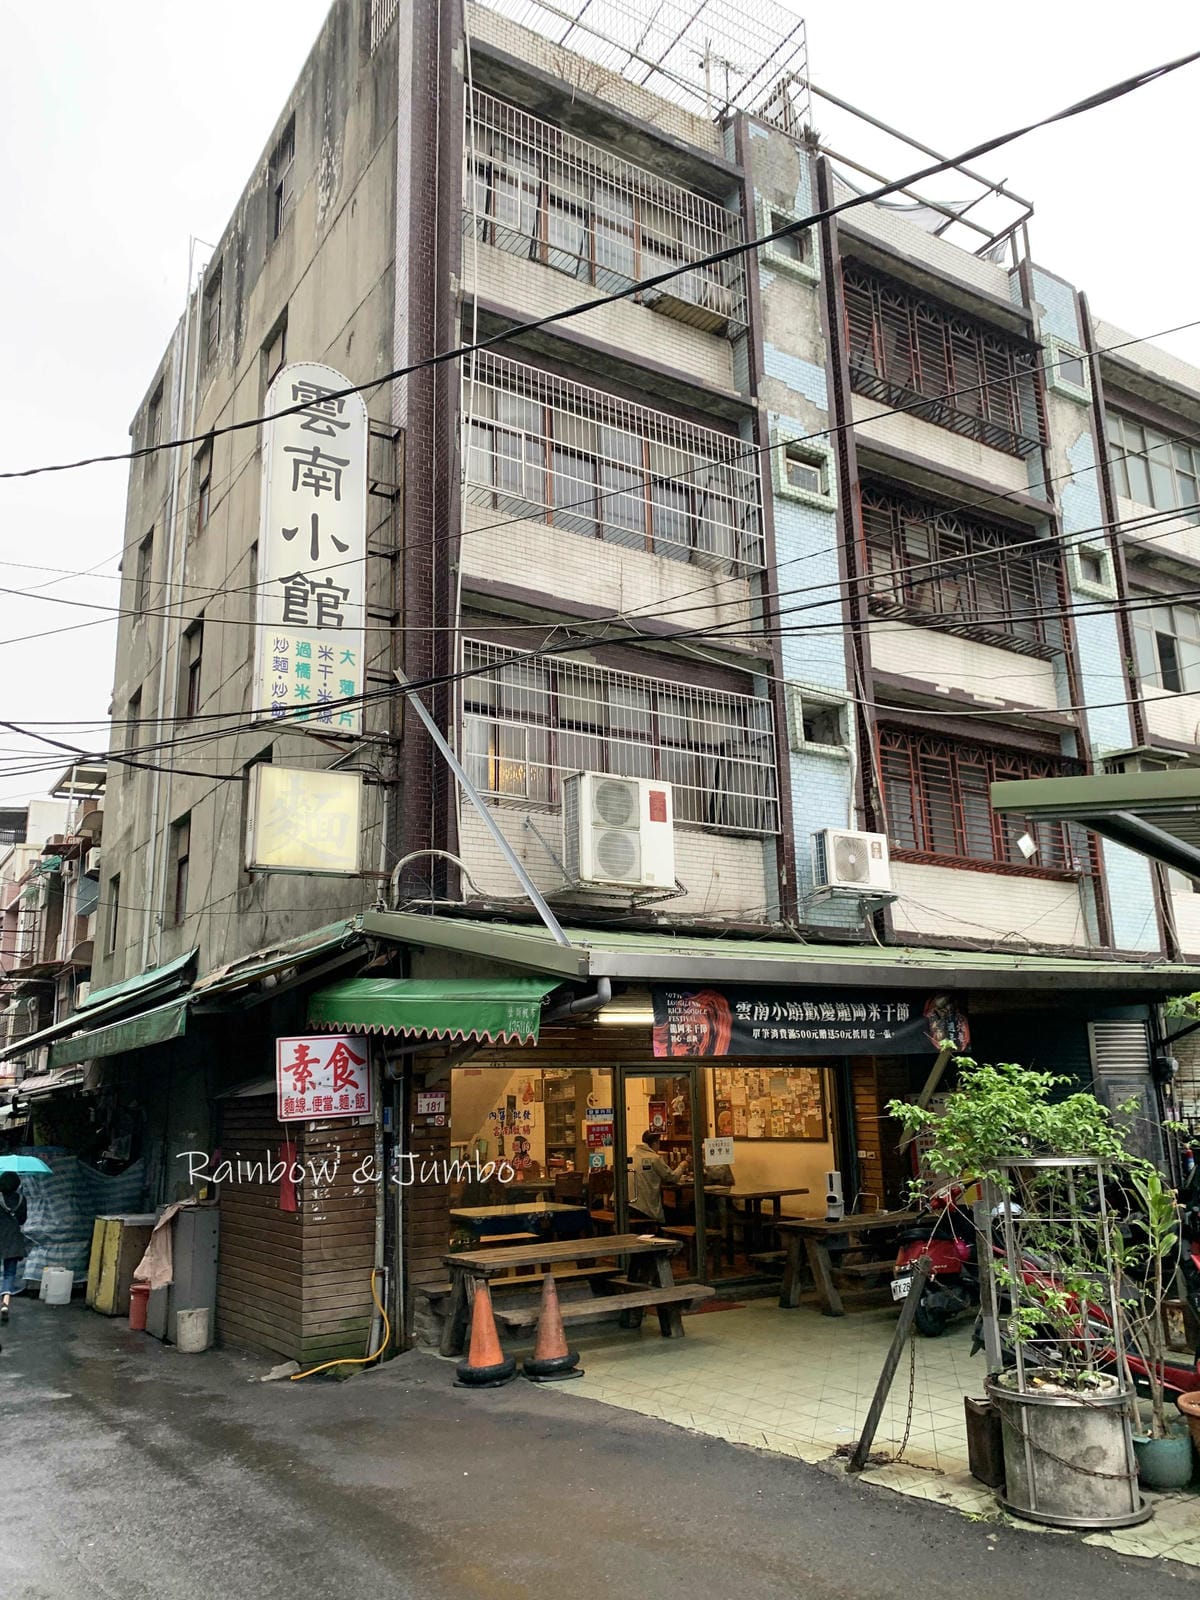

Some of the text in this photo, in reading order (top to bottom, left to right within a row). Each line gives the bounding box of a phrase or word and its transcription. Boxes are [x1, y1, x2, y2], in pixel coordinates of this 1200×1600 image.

[279, 379, 351, 630] 雲南小館
[339, 649, 356, 728] 大薄片
[283, 1041, 366, 1095] 素食
[426, 1101, 441, 1112] 181
